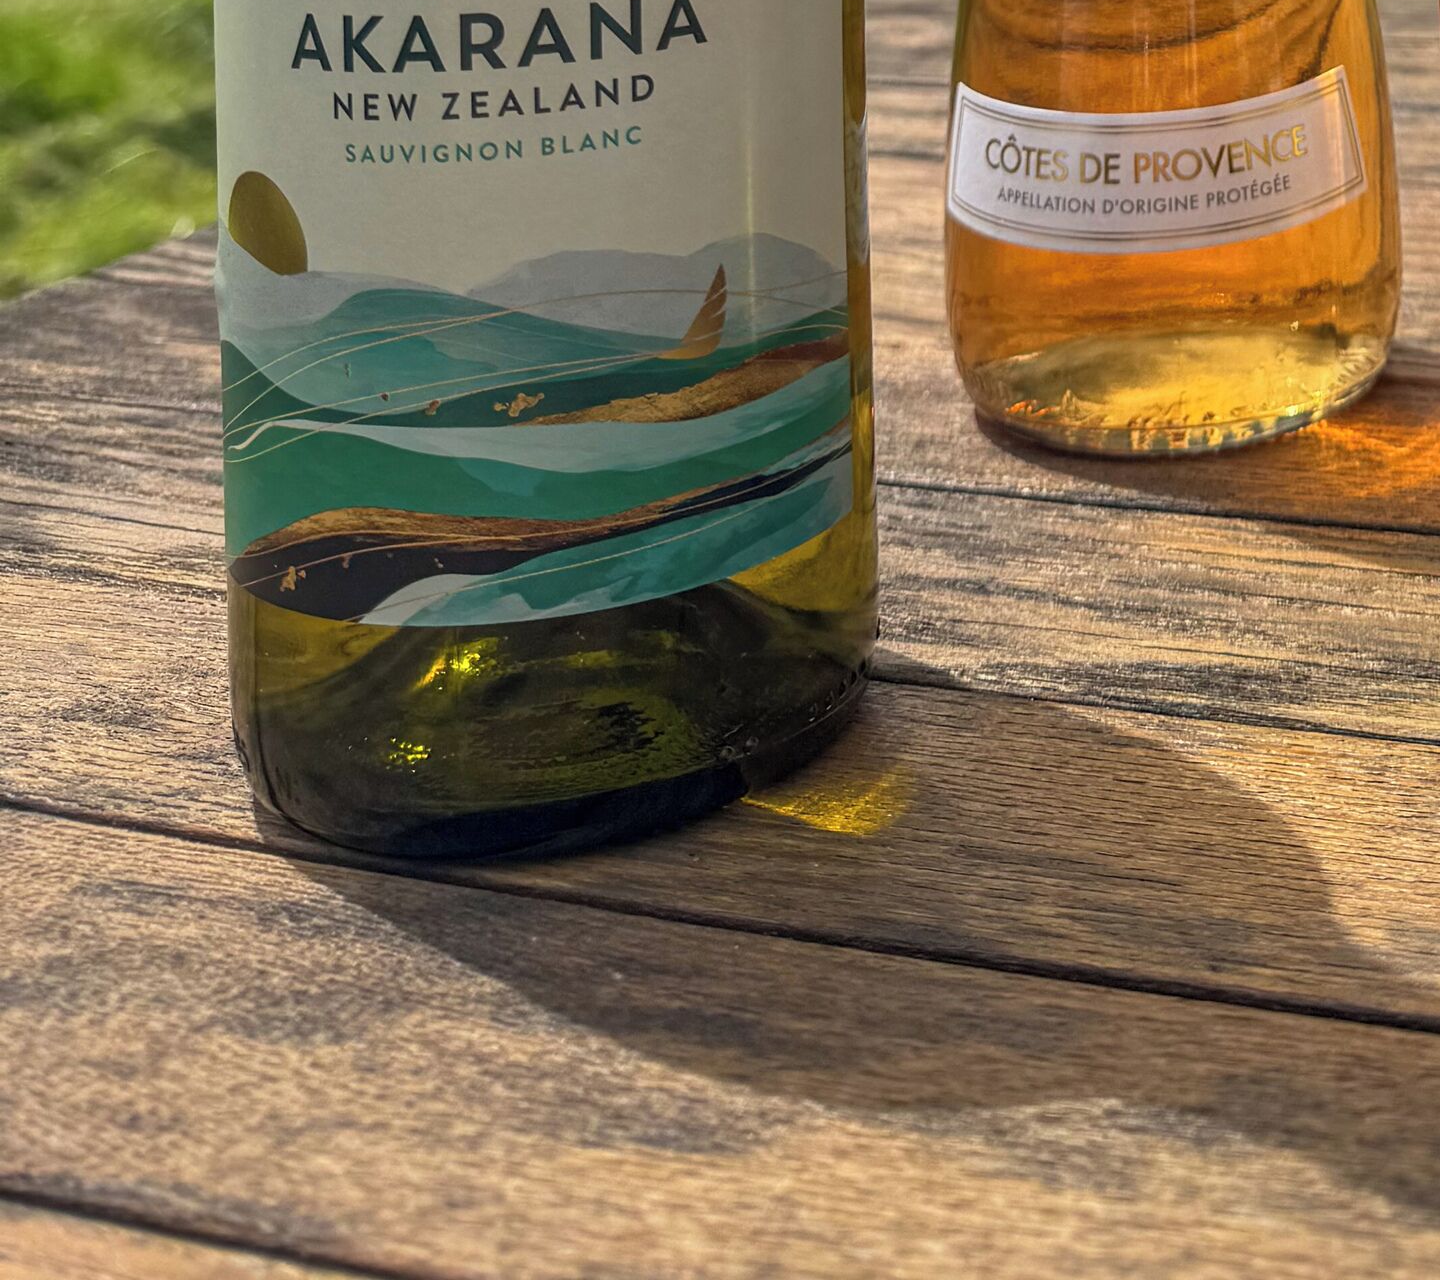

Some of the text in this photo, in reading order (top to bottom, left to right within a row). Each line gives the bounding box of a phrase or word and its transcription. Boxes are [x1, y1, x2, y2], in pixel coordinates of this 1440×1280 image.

[332, 73, 656, 122] NEW ZEALAND
[344, 124, 643, 164] SAUVIGNON BLANC
[984, 124, 1308, 185] CÔTES DE PROVENCE
[997, 173, 1292, 215] APPELLATION D'ORIGINE PROTÉGÉE
